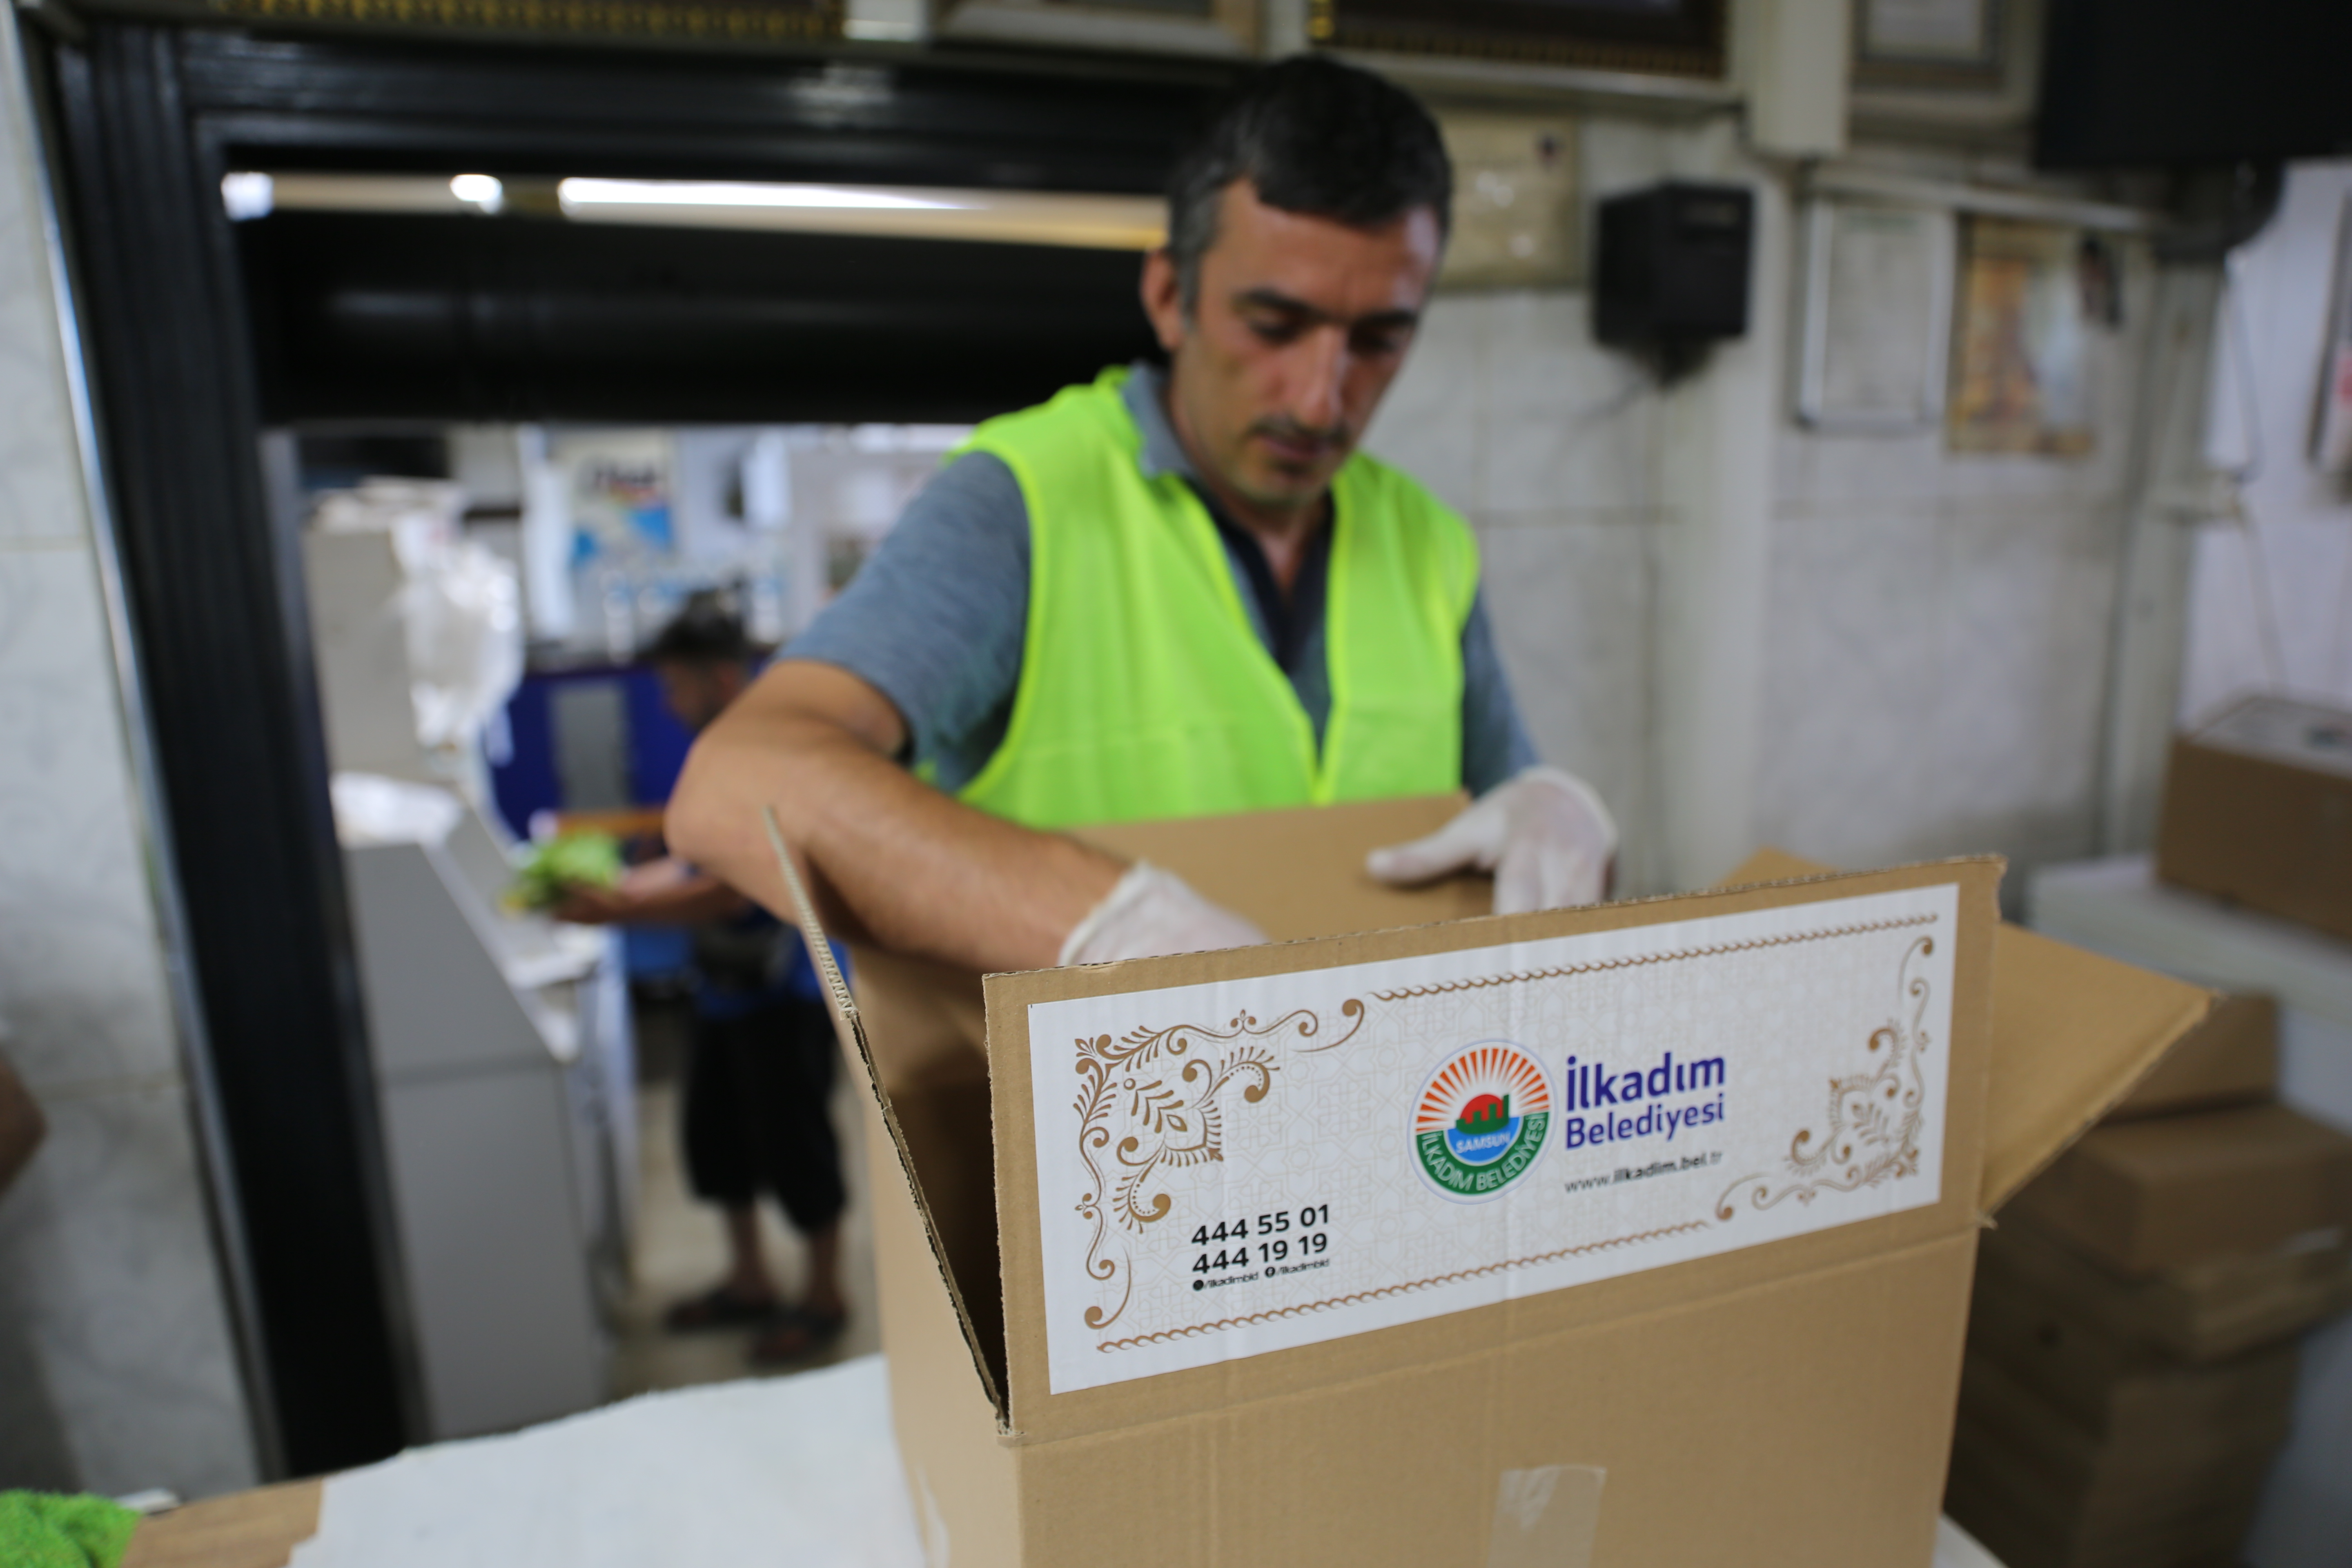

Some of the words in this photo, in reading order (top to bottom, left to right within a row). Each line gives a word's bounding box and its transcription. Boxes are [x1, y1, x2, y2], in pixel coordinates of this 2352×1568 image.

[1567, 1052, 1724, 1111] İlkadım
[1455, 1132, 1511, 1154] SAMSUN
[1566, 1093, 1724, 1149] Belediyesi
[1421, 1131, 1475, 1191] İLKADIM
[1476, 1113, 1546, 1191] BELEDİYESİ
[1191, 1219, 1248, 1245] 444
[1258, 1211, 1290, 1235] 55
[1300, 1204, 1328, 1227] 01
[1192, 1247, 1249, 1274] 444
[1258, 1240, 1288, 1263] 19
[1298, 1233, 1327, 1255] 19
